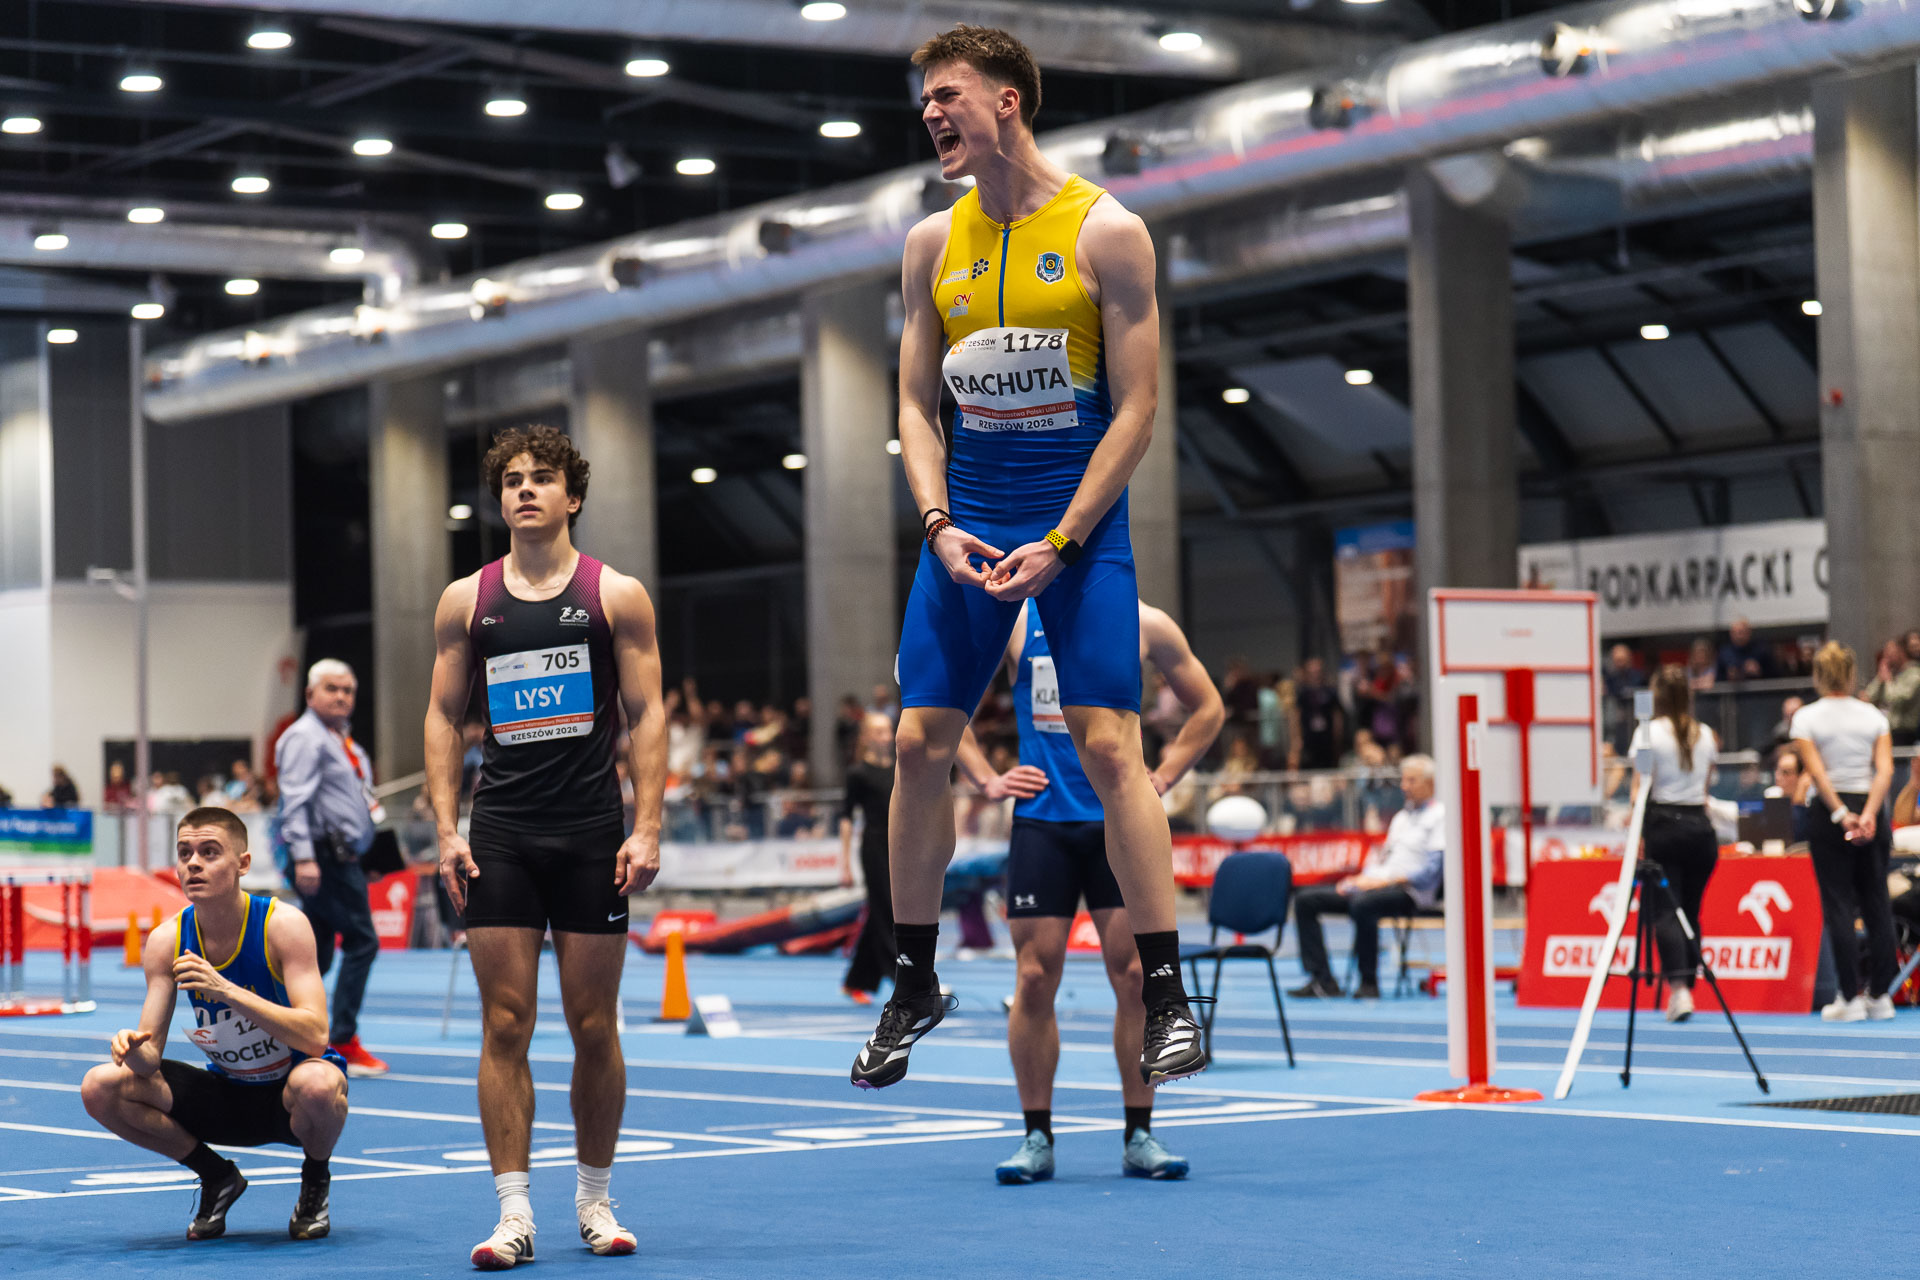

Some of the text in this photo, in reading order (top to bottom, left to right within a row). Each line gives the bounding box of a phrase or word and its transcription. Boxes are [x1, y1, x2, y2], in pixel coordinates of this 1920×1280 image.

[1003, 333, 1063, 353] 1178
[950, 367, 1068, 397] RACHUTA
[979, 418, 1054, 431] RZESZÓW 2026
[541, 650, 580, 672] 705
[514, 684, 565, 711] LYSY
[511, 726, 578, 742] RZESZÓW 2026
[1552, 945, 1629, 967] ORLN
[1702, 946, 1782, 970] ORLEN
[208, 1036, 280, 1063] ROCEK
